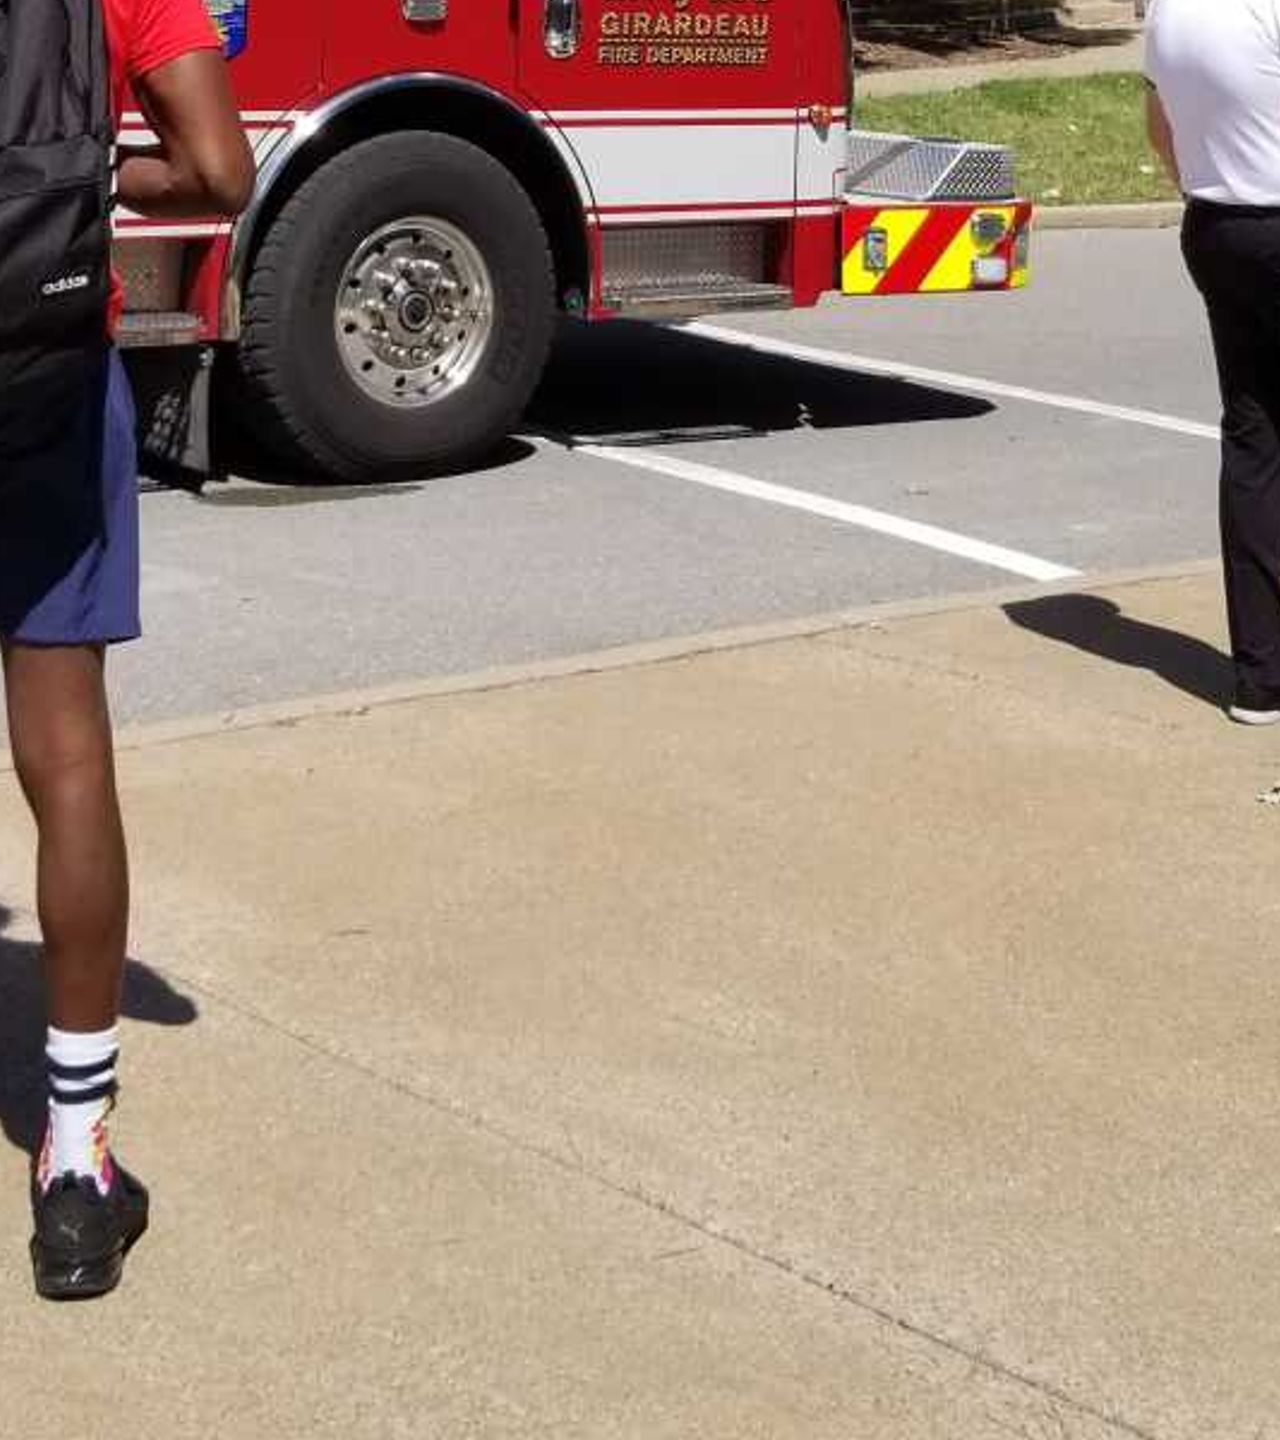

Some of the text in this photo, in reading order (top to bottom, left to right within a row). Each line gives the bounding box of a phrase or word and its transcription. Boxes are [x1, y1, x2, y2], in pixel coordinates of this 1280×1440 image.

[600, 11, 769, 36] GIRARDEAU
[599, 46, 769, 65] FIRE DEPARTMENT
[41, 273, 90, 296] adidas
